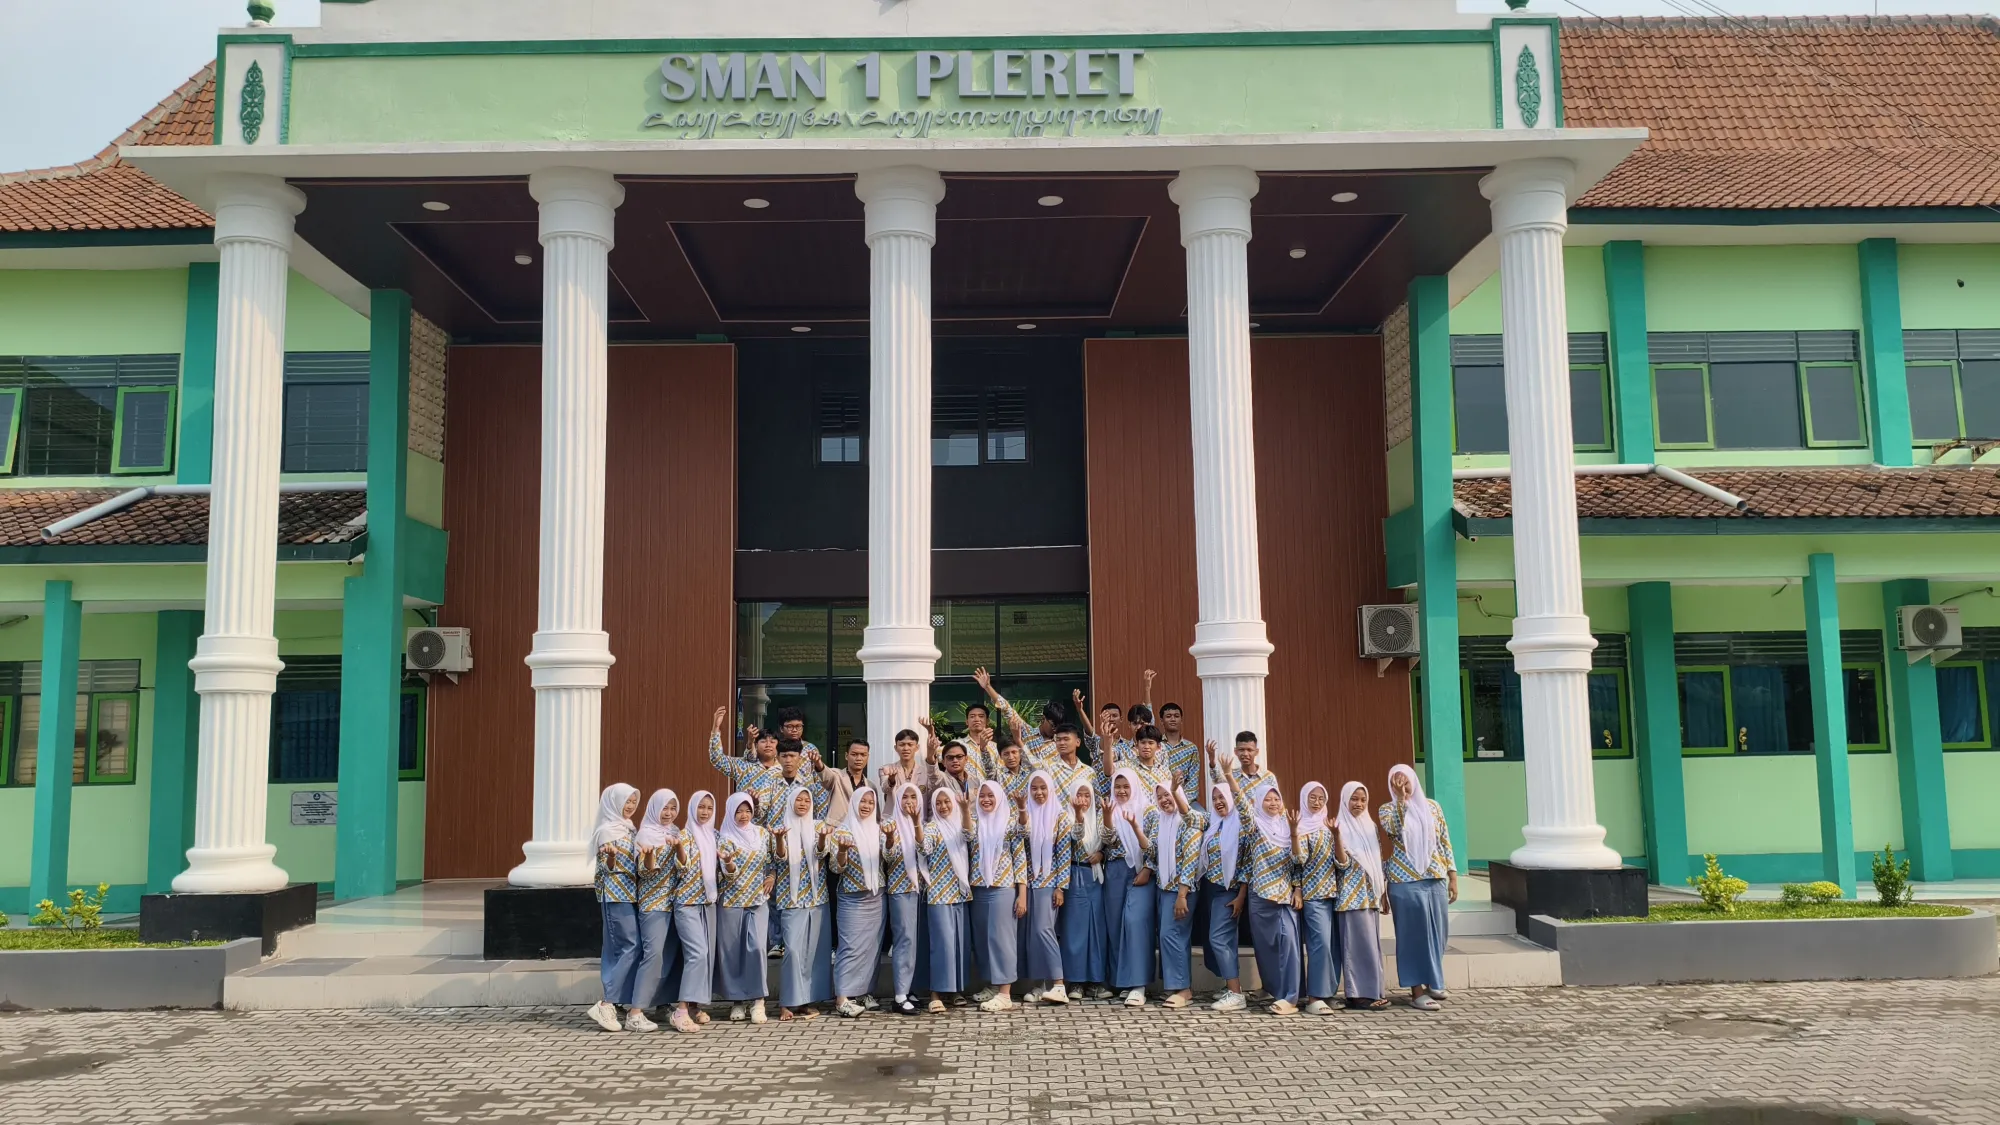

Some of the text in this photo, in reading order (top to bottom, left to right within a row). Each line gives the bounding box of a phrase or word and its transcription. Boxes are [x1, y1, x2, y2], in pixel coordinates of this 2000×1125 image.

[660, 48, 1145, 103] SMAN 1 PLERET
